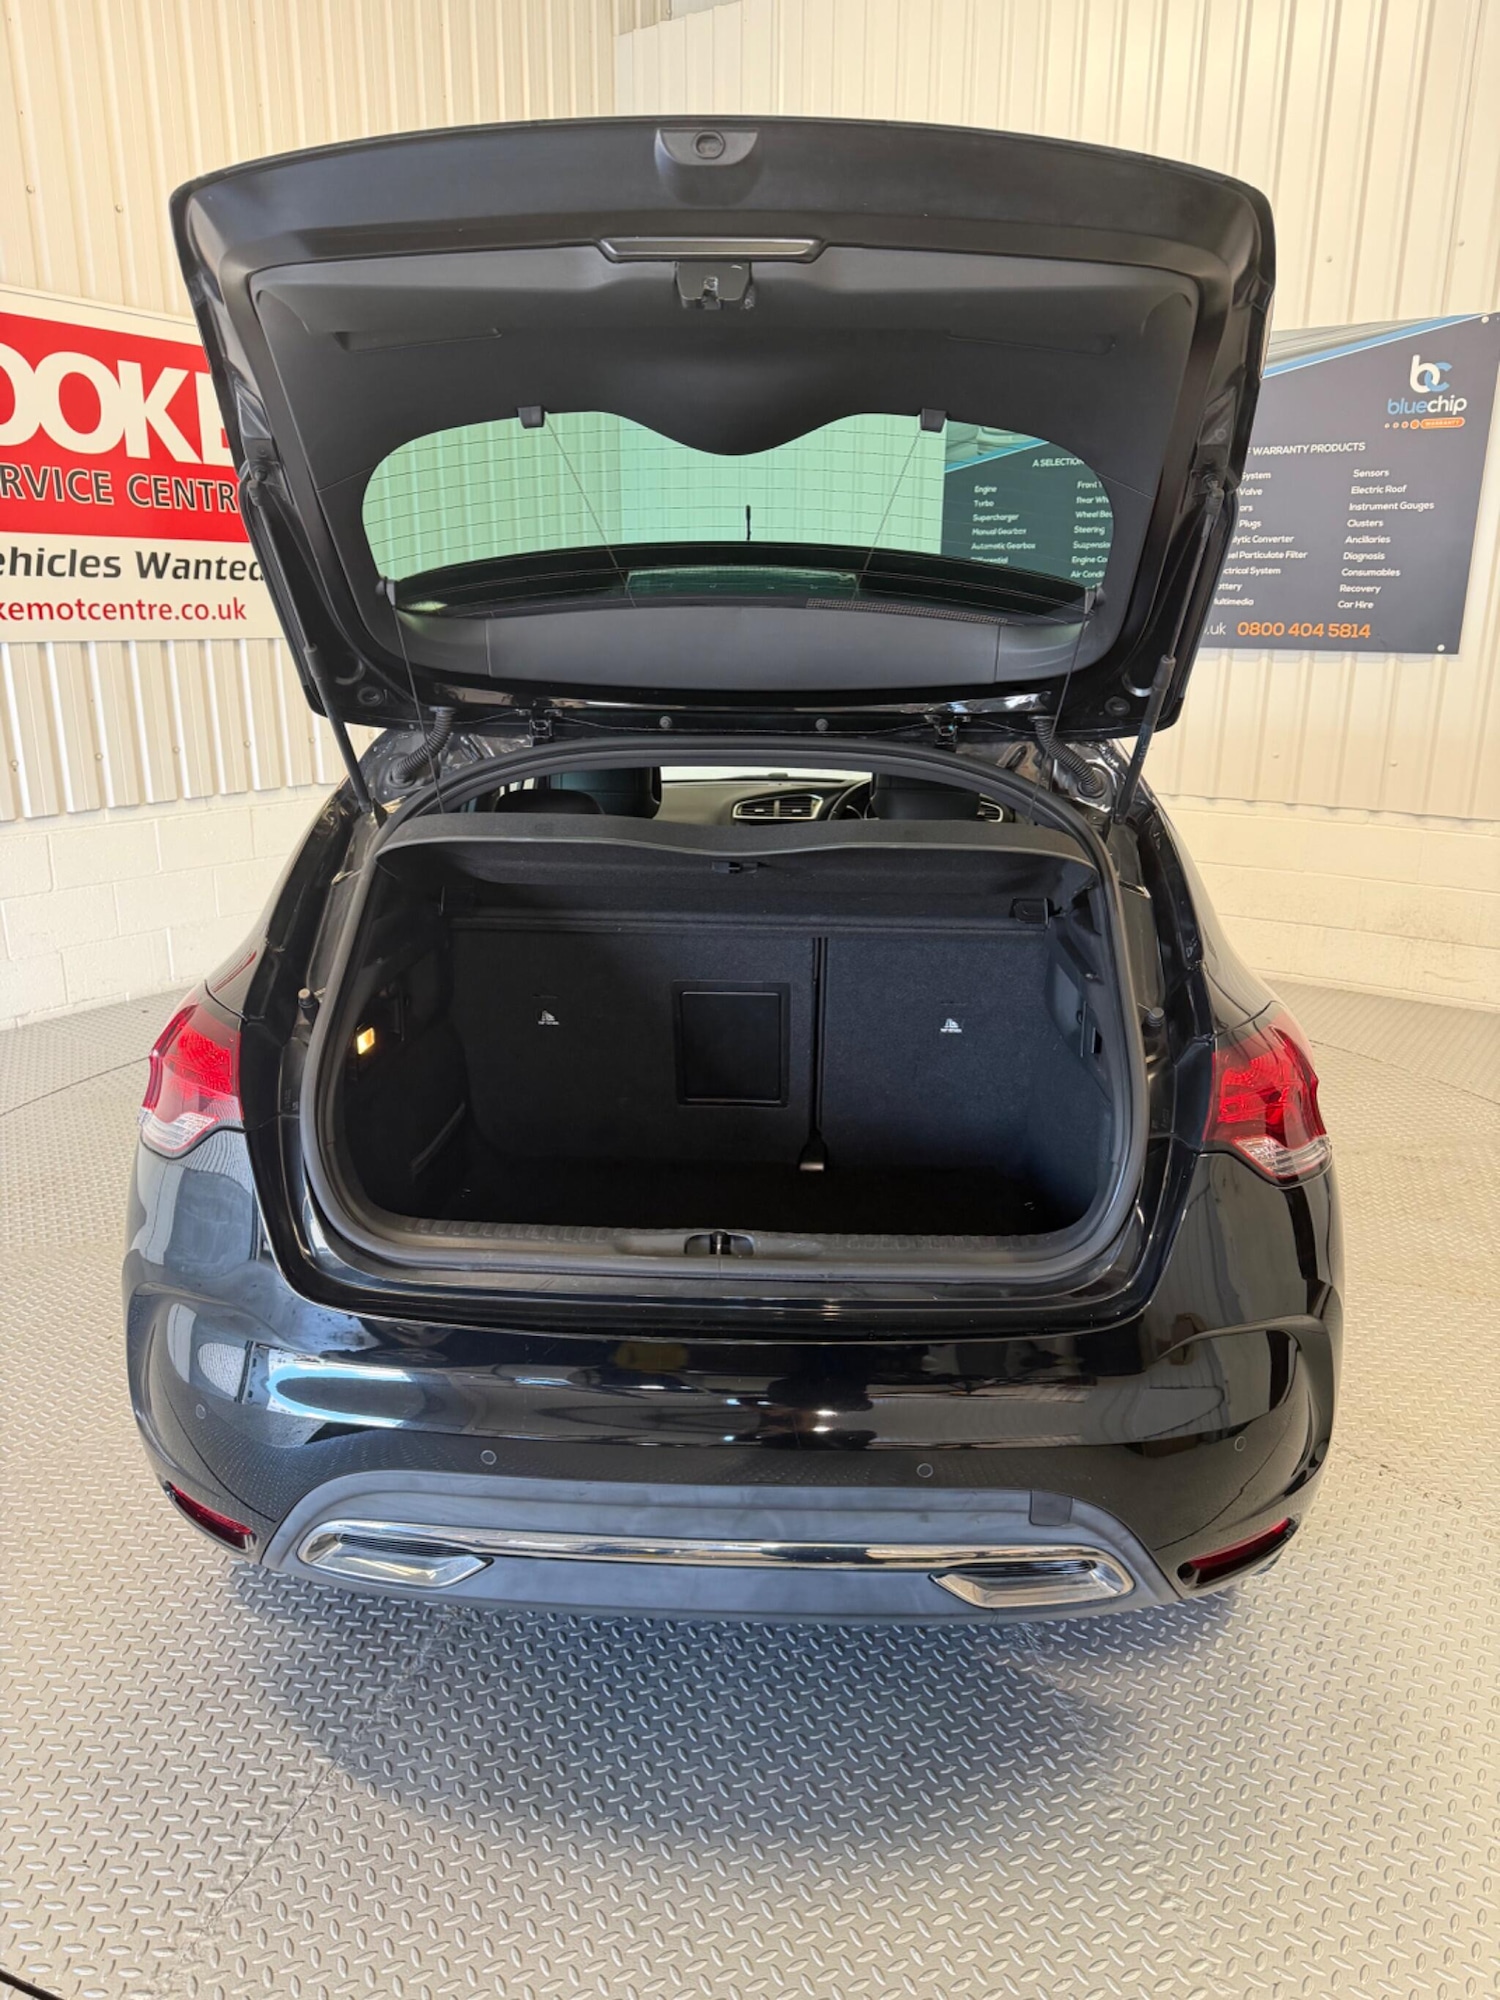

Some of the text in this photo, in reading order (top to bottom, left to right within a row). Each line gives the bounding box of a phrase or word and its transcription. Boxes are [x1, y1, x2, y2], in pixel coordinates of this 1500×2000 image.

[1387, 394, 1467, 415] bluechip
[1252, 445, 1310, 456] WARRANTY
[1310, 442, 1366, 454] PRODUCTS
[1032, 459, 1040, 467] A
[1242, 471, 1271, 481] System
[1353, 469, 1390, 478] Sensors
[1077, 480, 1098, 489] Front
[1351, 484, 1407, 494] Electric Roof
[127, 474, 240, 513] CENTR
[974, 485, 997, 494] Engine
[1240, 487, 1263, 496] Valve
[974, 499, 995, 508] Turbo
[1076, 495, 1094, 504] Rear
[1349, 501, 1435, 512] Instrument Gauges
[972, 513, 1019, 523] Supercharger
[1075, 510, 1099, 518] Wheel
[1239, 520, 1262, 530] Plugs
[1347, 519, 1384, 528] Clusters
[971, 527, 997, 536] Manual
[1074, 525, 1106, 535] Steering
[1252, 534, 1294, 544] Converter
[1344, 535, 1391, 544] Ancillaries
[1006, 541, 1036, 550] Gearbox
[1239, 550, 1284, 559] Particulate
[1285, 550, 1308, 559] Filter
[1343, 551, 1385, 562] Diagnosis
[1071, 555, 1096, 565] Engine
[1070, 569, 1082, 578] Air
[1250, 566, 1281, 576] System
[1341, 568, 1401, 577] Consumables
[1340, 584, 1382, 594] Recovery
[1337, 600, 1374, 609] Car Hire
[1204, 621, 1371, 638] .uk 0800 404 5814
